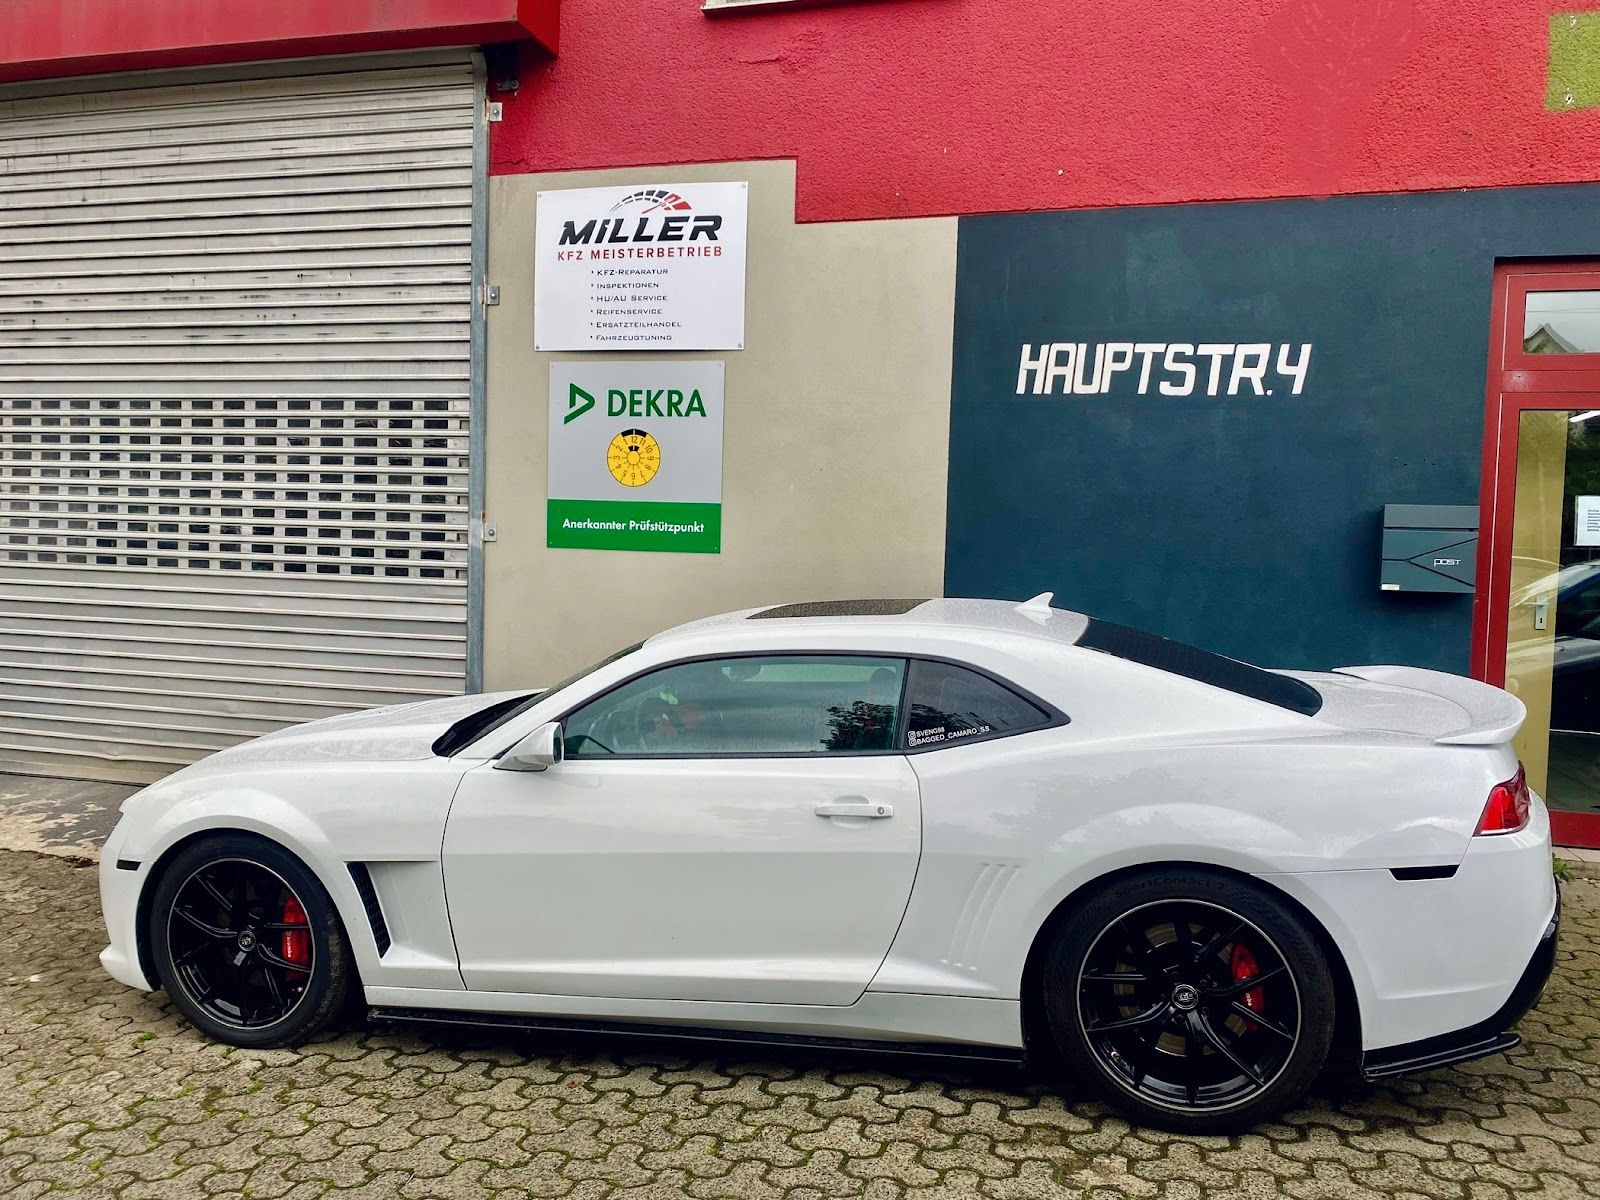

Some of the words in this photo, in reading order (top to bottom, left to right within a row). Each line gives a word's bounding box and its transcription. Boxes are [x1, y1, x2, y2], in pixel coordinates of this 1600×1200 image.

[558, 215, 723, 246] MILLER
[557, 250, 583, 261] KFZ
[590, 246, 722, 260] MEISTERBETRIEB
[607, 388, 707, 418] DEKRA
[562, 518, 627, 531] Anerkannter
[629, 520, 705, 535] Prüfstützpunkt
